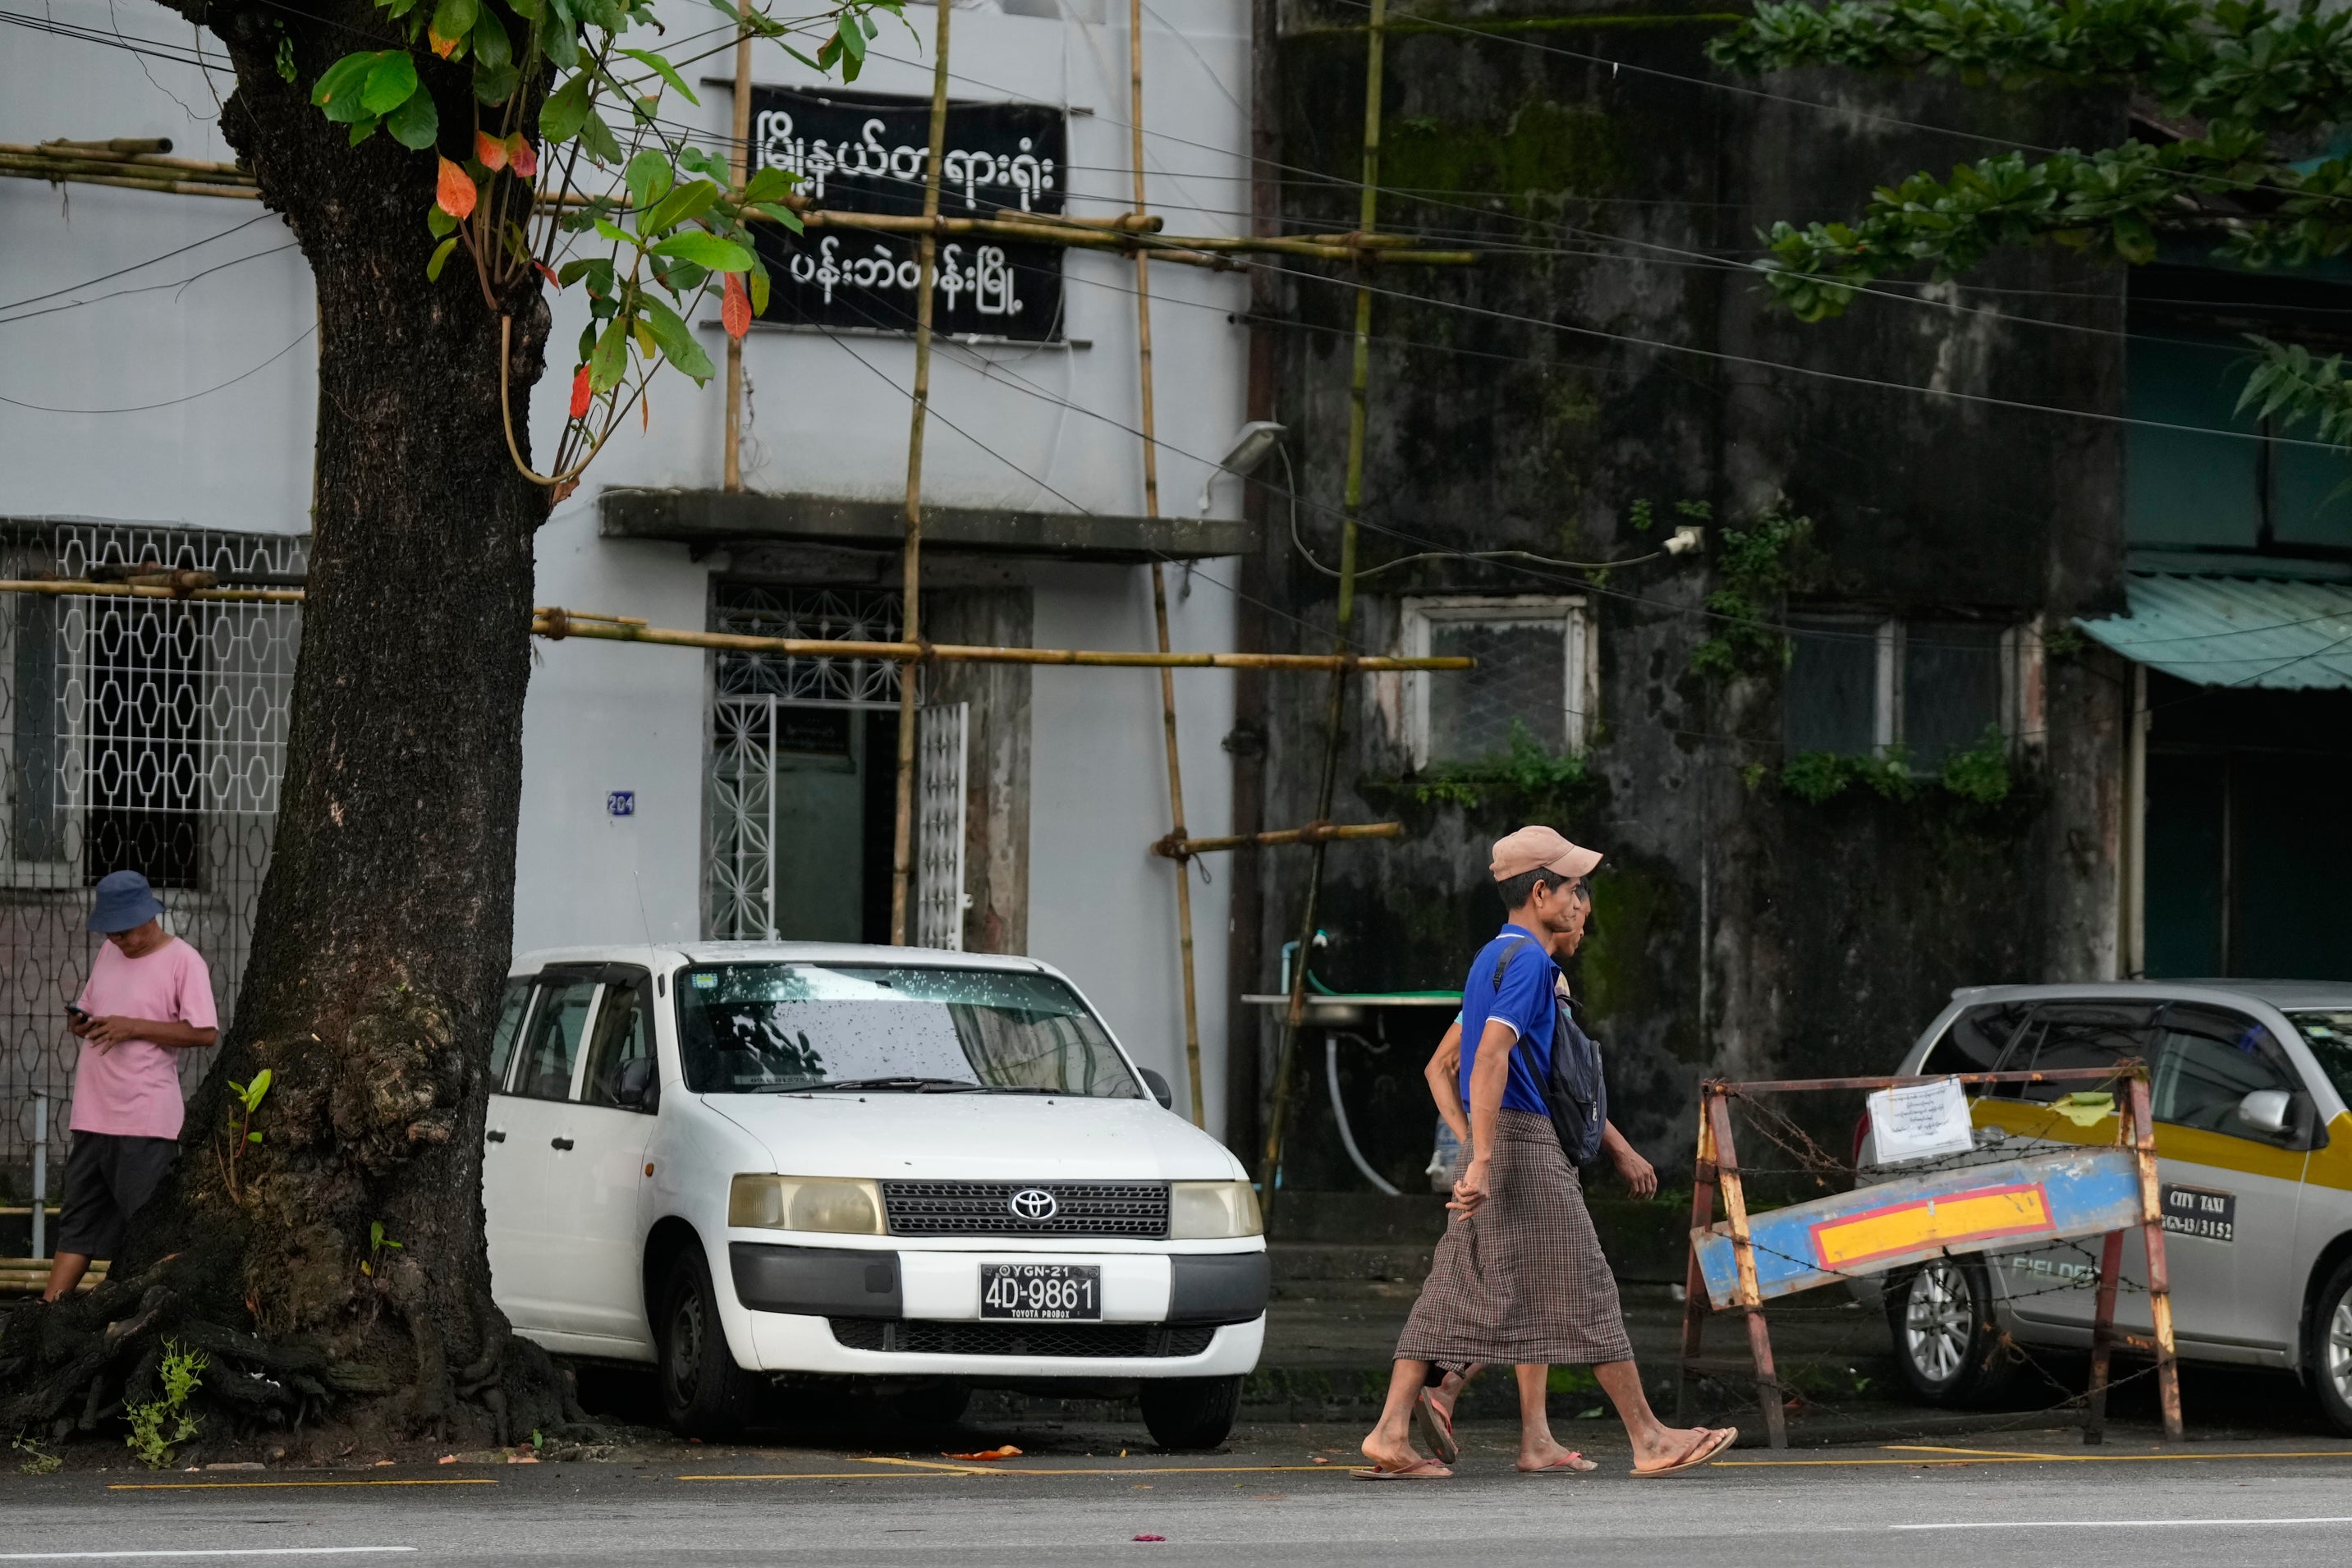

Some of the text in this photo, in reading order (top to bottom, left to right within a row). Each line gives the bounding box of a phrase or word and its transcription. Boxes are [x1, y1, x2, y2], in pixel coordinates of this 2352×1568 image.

[609, 795, 633, 812] 204
[2170, 1190, 2225, 1213] CITY TAXI
[985, 1277, 1092, 1309] 4D-9861
[1011, 1309, 1070, 1318] TOYOTA PROBOX
